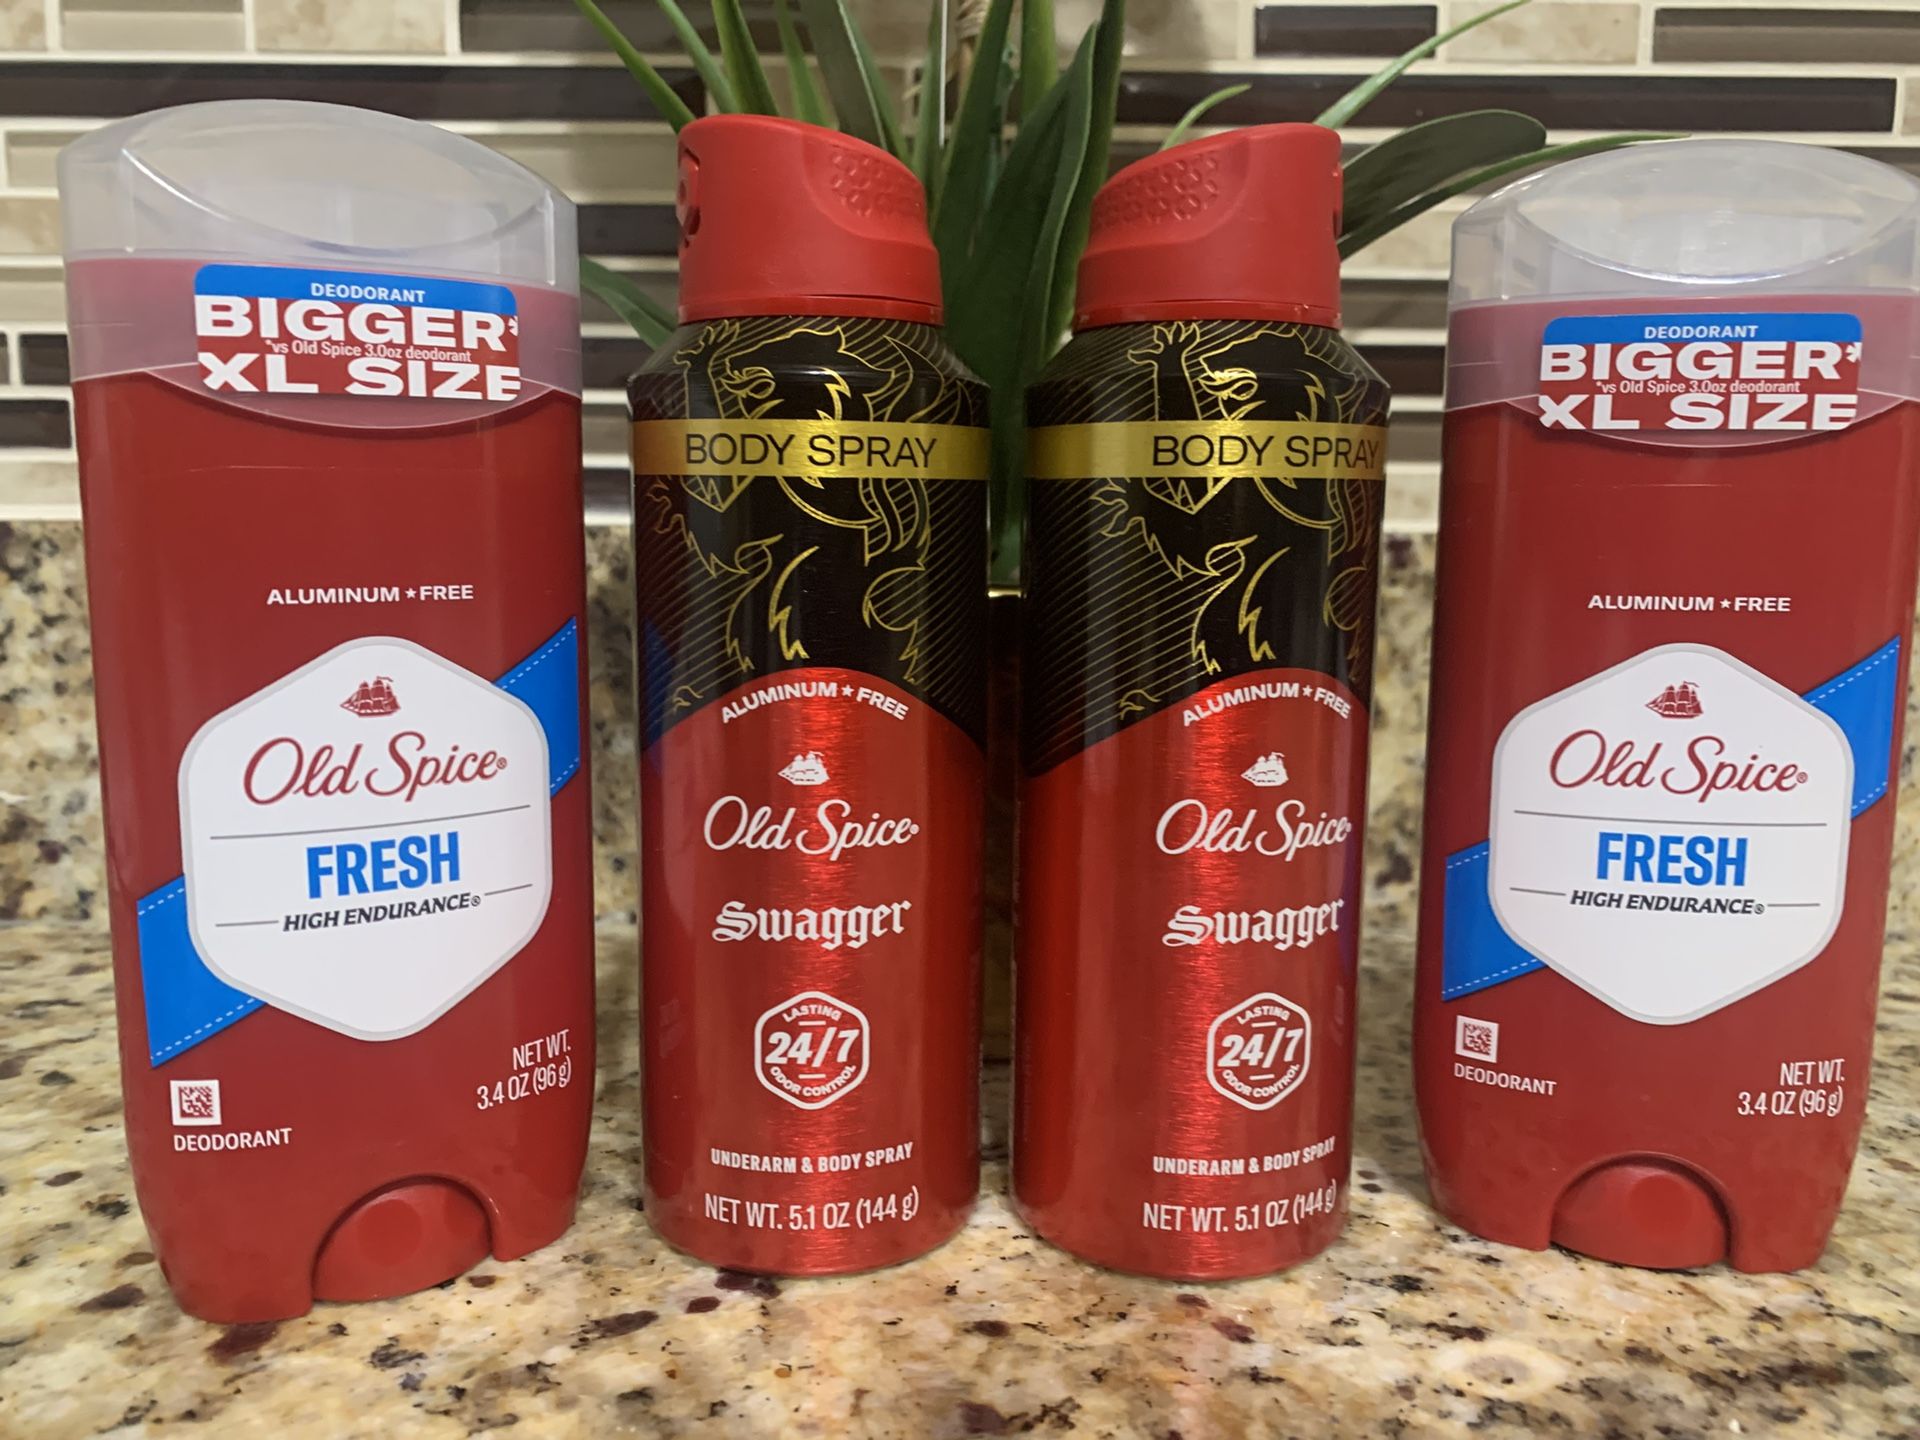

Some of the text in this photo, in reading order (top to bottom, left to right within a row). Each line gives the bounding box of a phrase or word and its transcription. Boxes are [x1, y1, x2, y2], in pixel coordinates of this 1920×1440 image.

[311, 282, 426, 303] DEODORANT
[1644, 325, 1759, 339] DEODORANT
[292, 341, 318, 355] Old
[321, 342, 361, 358] Spice
[365, 344, 402, 358] 3.0oz
[406, 346, 471, 362] deodorant
[198, 352, 520, 401] XL SIZE
[1620, 380, 1644, 394] Old
[1647, 380, 1686, 396] Spice
[1689, 381, 1726, 394] 3.0oz
[1730, 380, 1800, 393] deodorant
[1538, 393, 1858, 430] XL SIZE
[686, 433, 937, 468] BODY SPRAY
[1152, 435, 1380, 469] BODY SPRAY
[243, 737, 362, 805] Old
[1549, 729, 1662, 789] Old
[703, 795, 796, 850] Old
[1156, 798, 1258, 855] Old
[307, 831, 460, 899] FRESH
[1596, 832, 1748, 886] FRESH
[1570, 890, 1625, 909] HIGH
[283, 911, 339, 931] HIGH
[711, 900, 912, 950] Swagger
[1162, 899, 1344, 951] Swagger
[783, 1004, 842, 1022] LASTING
[1236, 1005, 1290, 1025] LASTING
[513, 1030, 571, 1070] NET WT.
[765, 1027, 860, 1068] 24/7
[1217, 1027, 1304, 1068] 24/7
[477, 1056, 571, 1110] 3.4 OZ (96 g)
[770, 1064, 857, 1097] ODOR CONTROL
[1222, 1064, 1300, 1098] ODOR CONTROL
[1454, 1062, 1557, 1096] DEODORANT
[1780, 1059, 1845, 1086] NET WT.
[1737, 1086, 1843, 1117] 3.4 OZ (96 g)
[173, 1127, 293, 1151] DEODORANT
[1153, 1136, 1336, 1176] UNDERARM & BODY SPRAY
[710, 1142, 913, 1173] UNDERARM & BODY SPRAY
[704, 1185, 919, 1231] NET WT. 5.1 OZ (144 g)
[1143, 1178, 1337, 1233] NET WT. 5.1 OZ (144 g)
